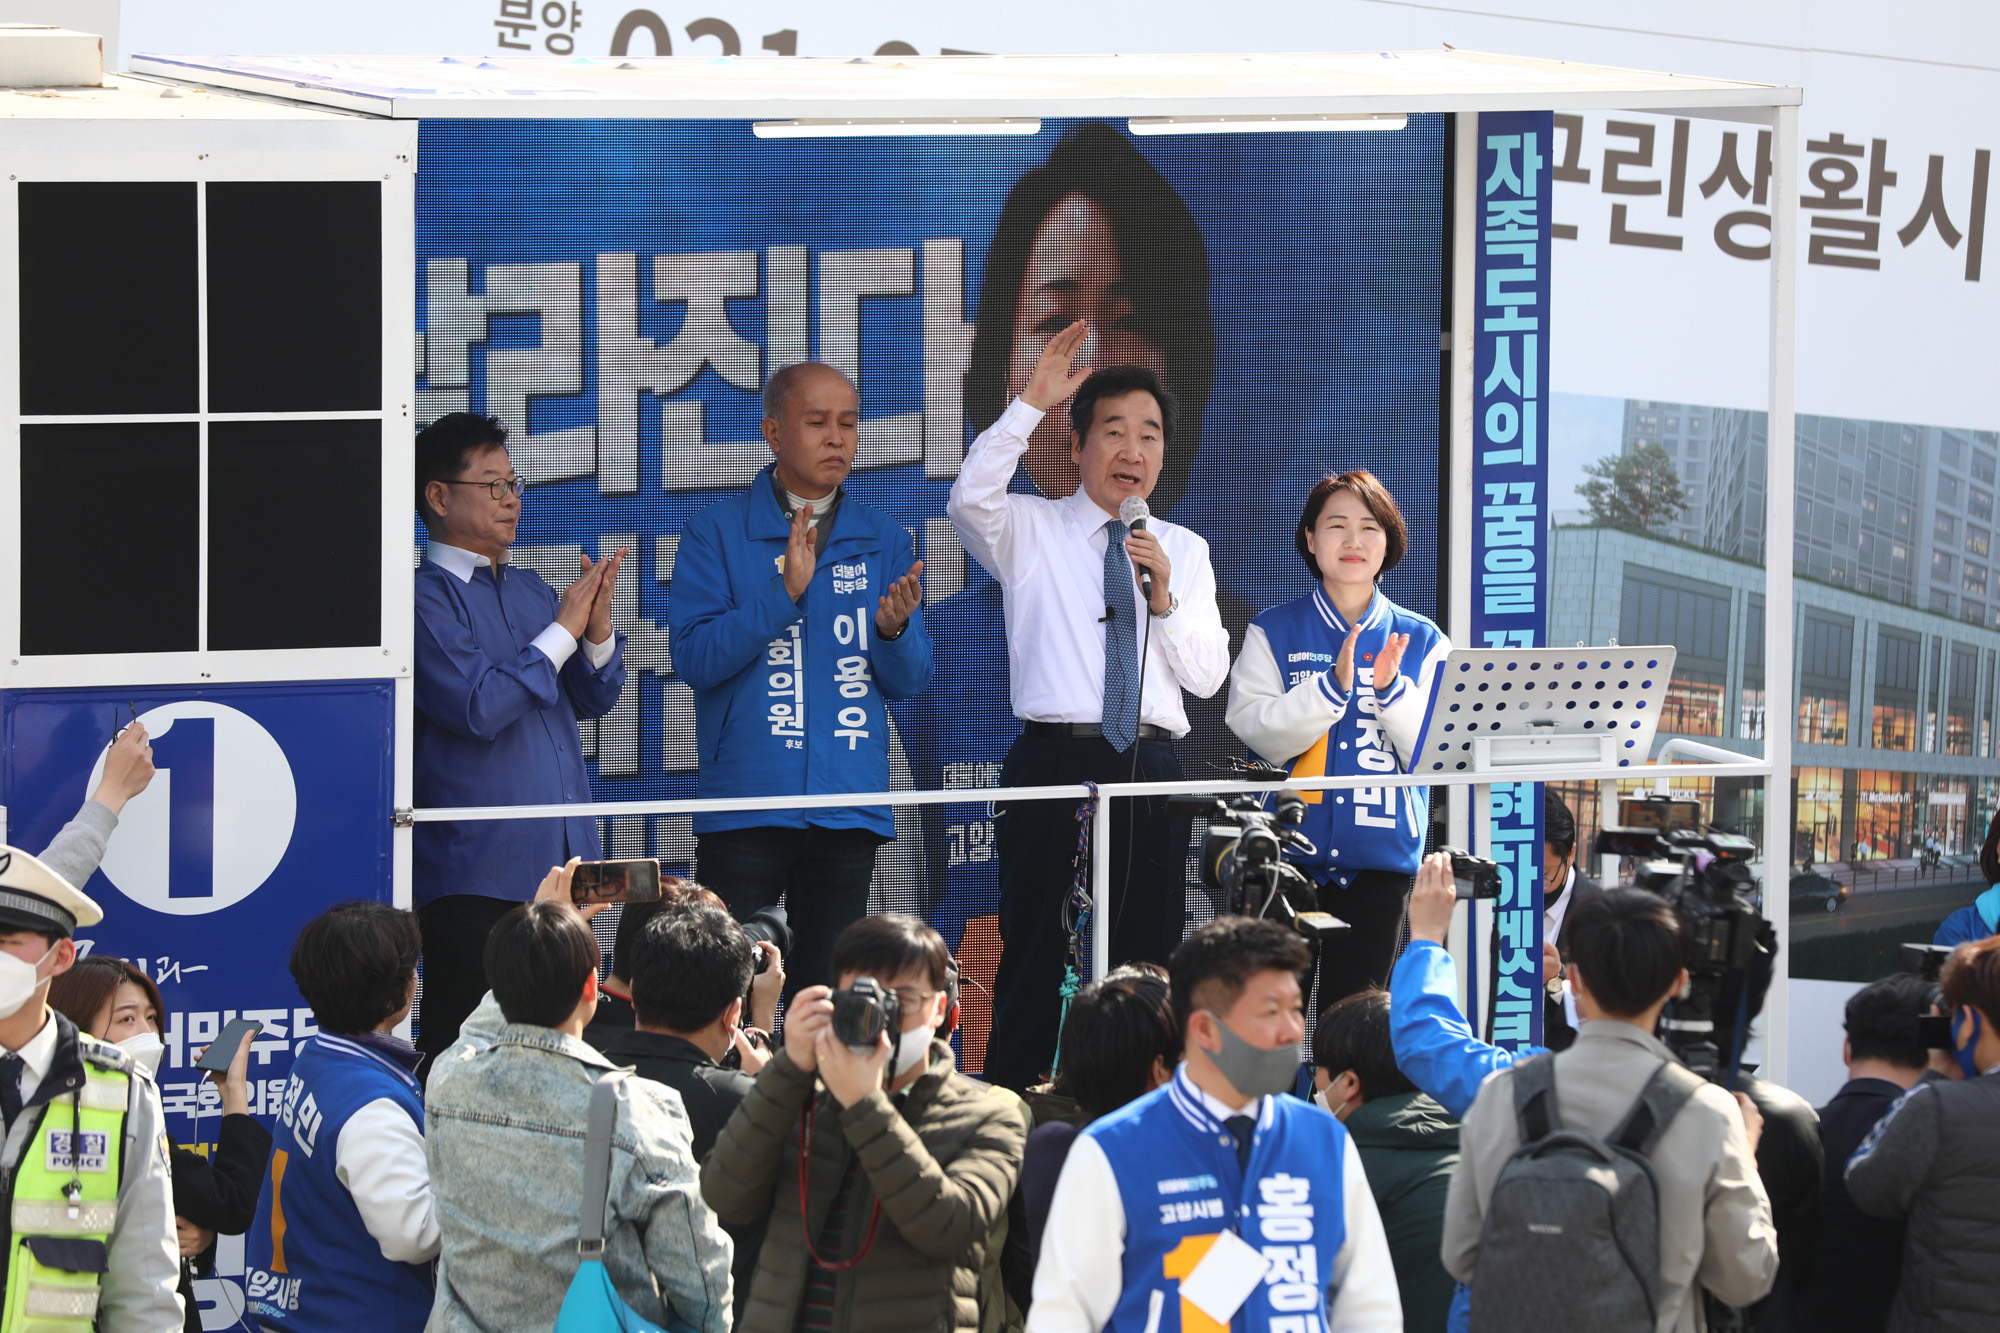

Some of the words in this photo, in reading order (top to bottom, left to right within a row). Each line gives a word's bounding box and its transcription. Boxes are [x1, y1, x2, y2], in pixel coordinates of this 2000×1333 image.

[1483, 131, 1543, 465] 자족도시의
[1482, 482, 1537, 614] 꿈을
[832, 562, 867, 579] 더불어
[833, 578, 868, 594] 민주당
[833, 607, 871, 750] 이용우
[1289, 670, 1317, 685] 고양
[785, 739, 803, 750] 후보
[148, 717, 215, 898] 1
[276, 1072, 323, 1158] 정민
[53, 1132, 104, 1156] 경찰
[53, 1156, 103, 1168] POICE
[246, 1267, 302, 1311] 양시병
